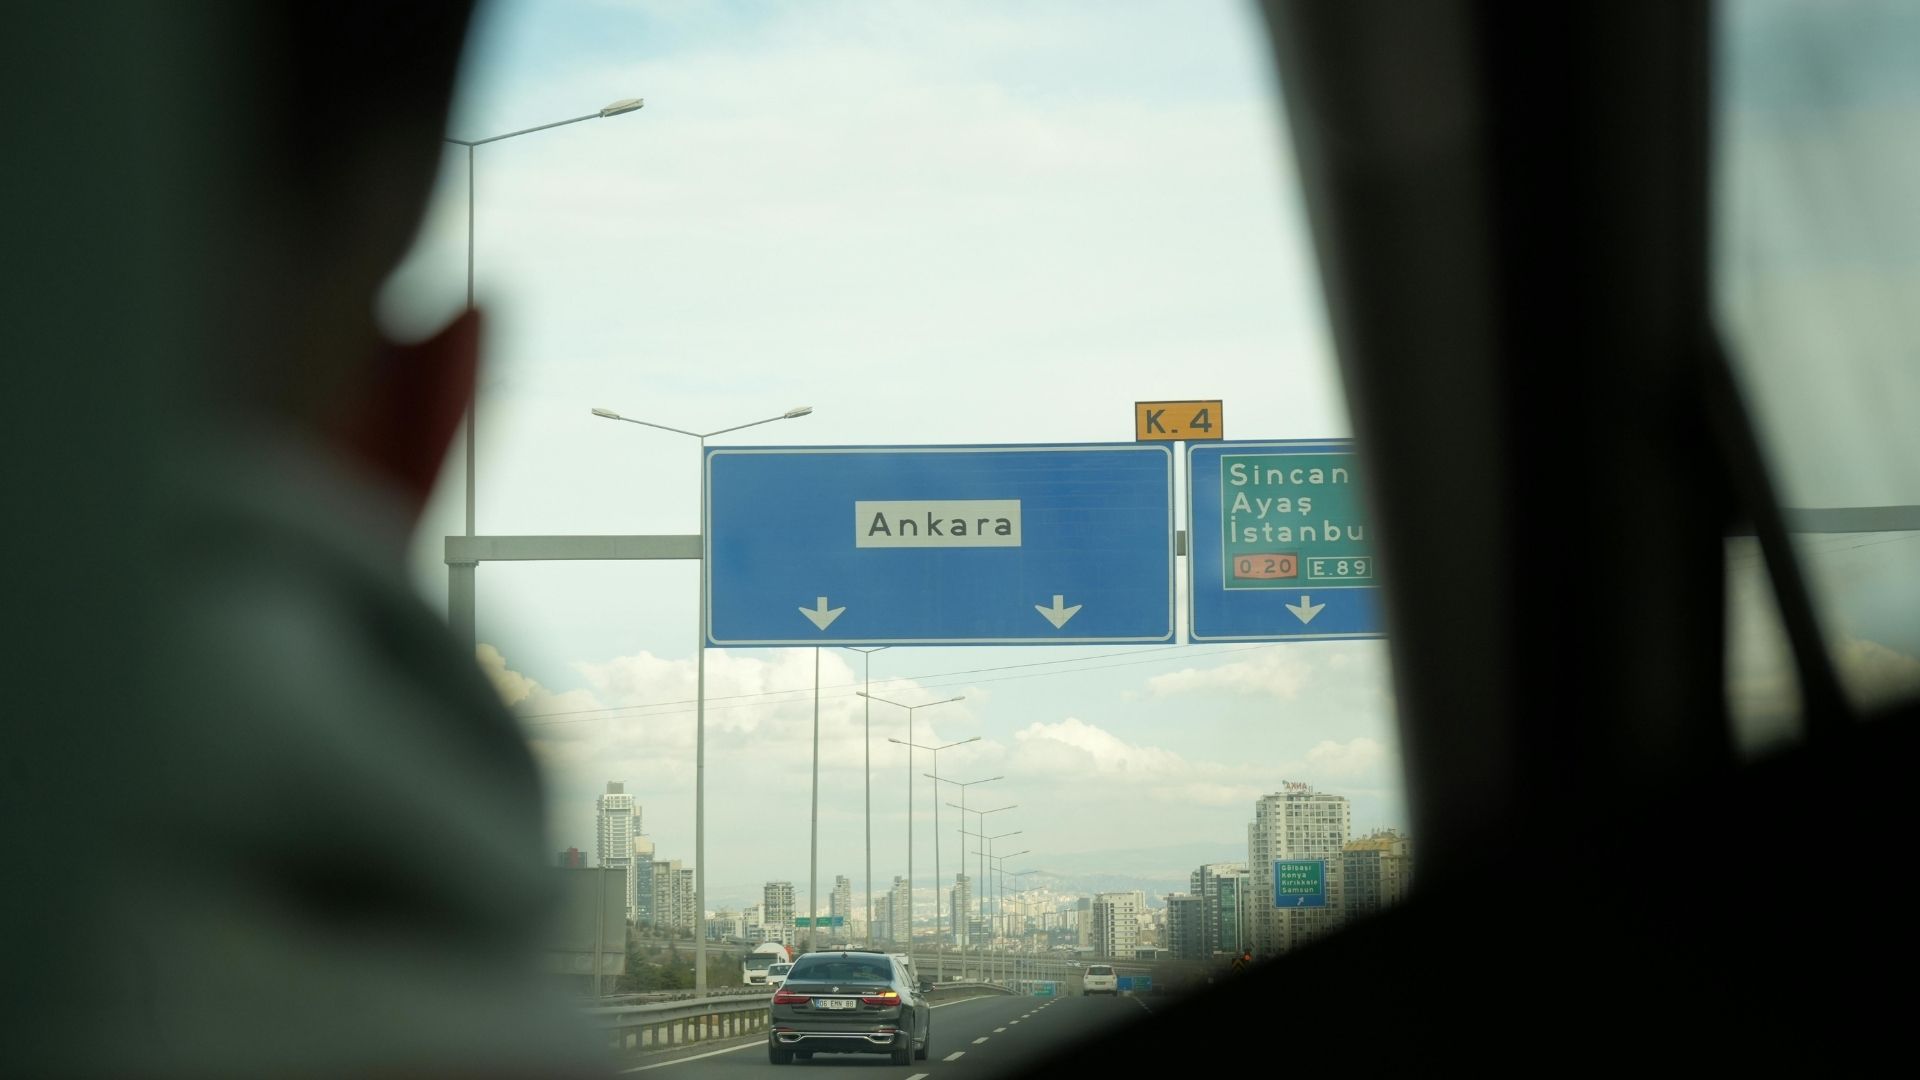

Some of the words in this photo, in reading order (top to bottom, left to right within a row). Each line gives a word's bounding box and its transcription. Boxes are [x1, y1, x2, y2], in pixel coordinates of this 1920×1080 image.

[1230, 463, 1349, 486] Sincan
[1231, 492, 1312, 519] Ayaş
[868, 512, 1012, 537] Ankara
[1231, 516, 1364, 543] İstanbu
[1313, 560, 1367, 575] E.89
